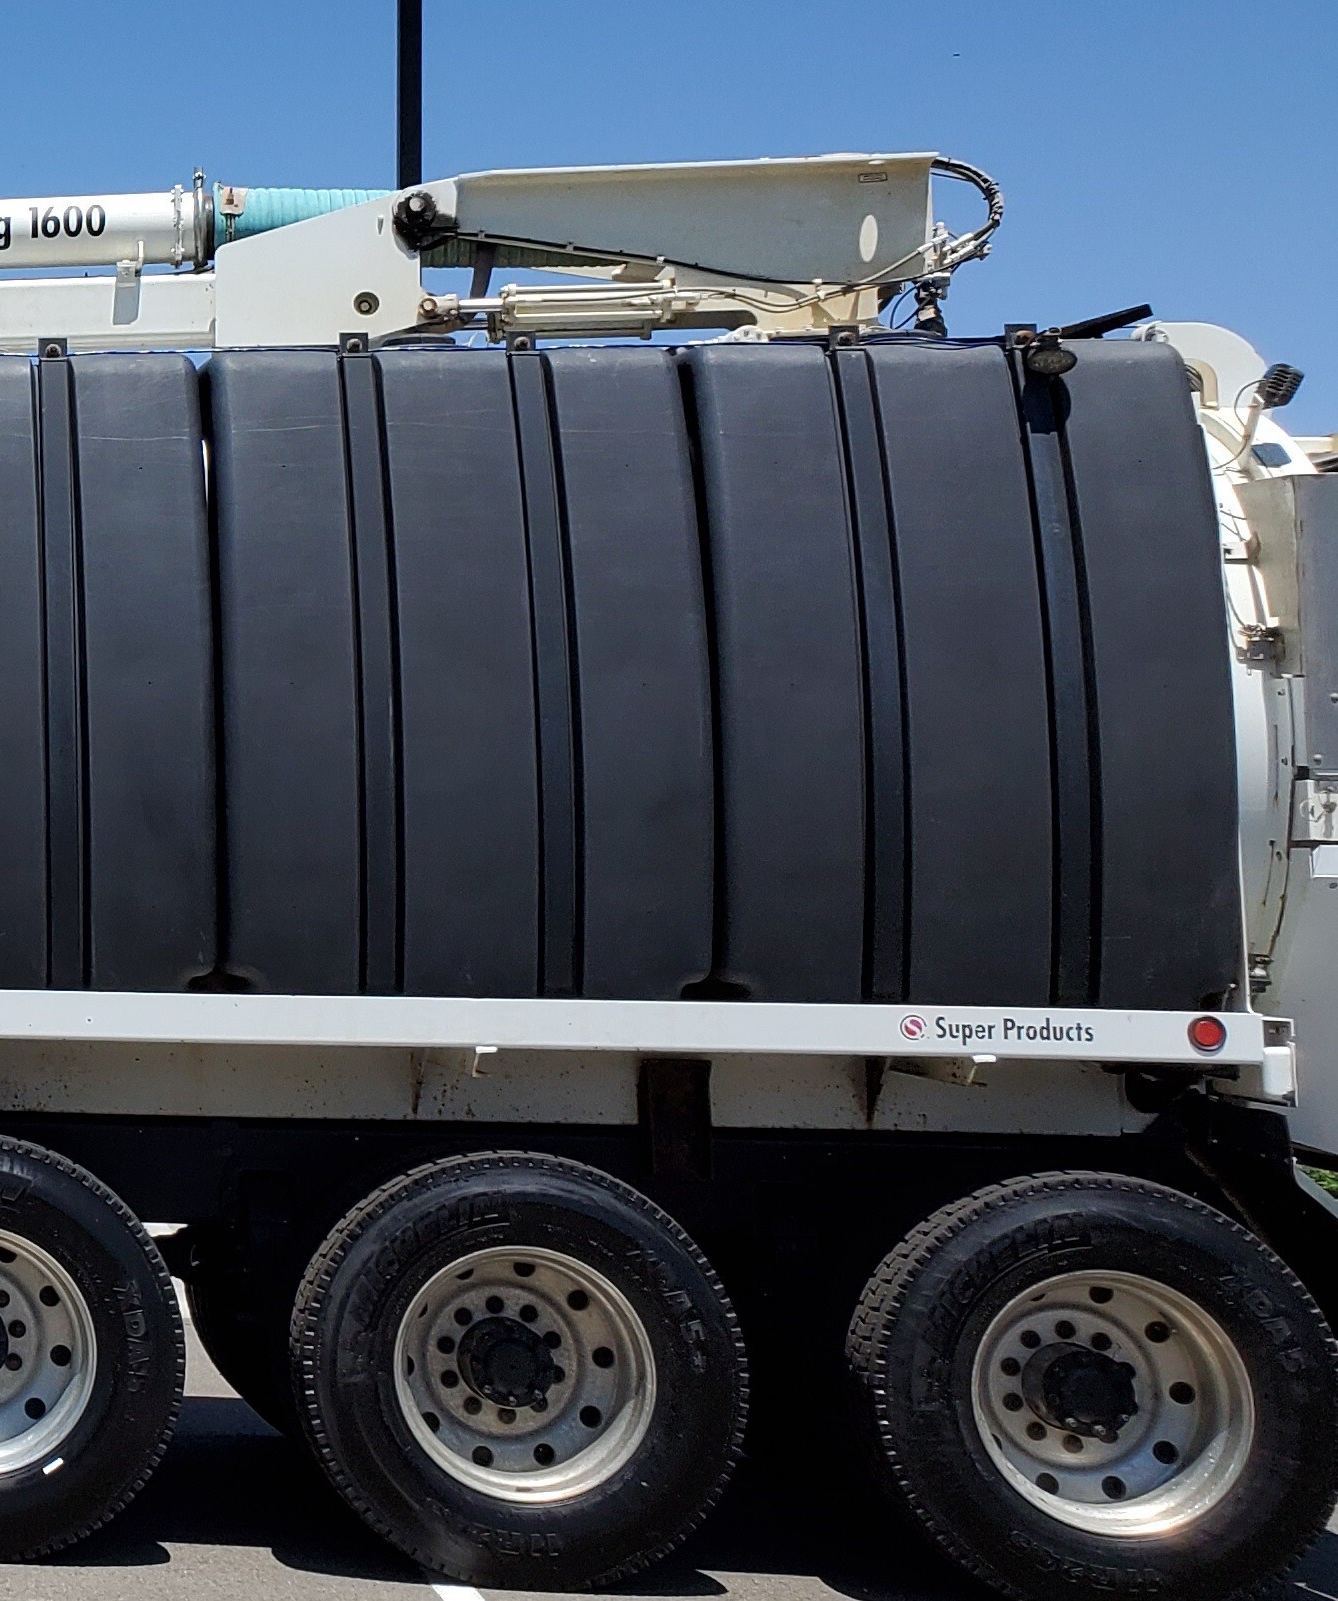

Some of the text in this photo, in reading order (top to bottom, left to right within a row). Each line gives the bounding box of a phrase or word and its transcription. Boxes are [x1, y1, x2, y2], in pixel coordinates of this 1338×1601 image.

[28, 204, 106, 239] 1600
[935, 1016, 1095, 1046] Super Products
